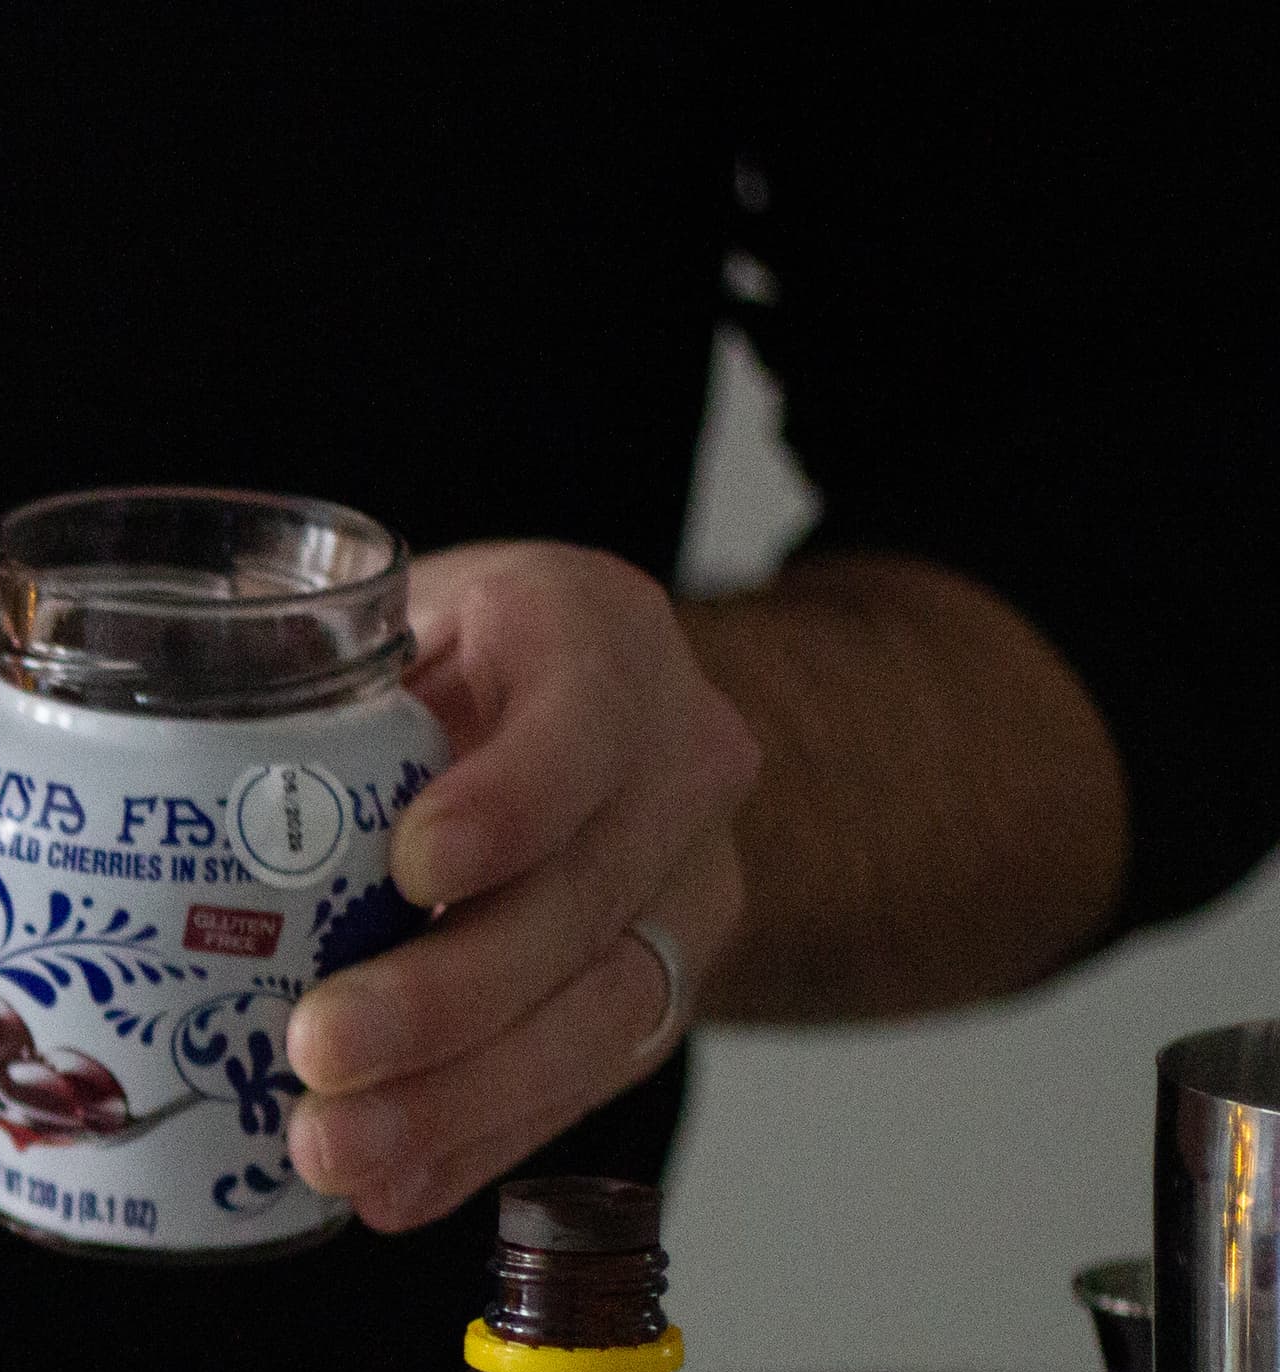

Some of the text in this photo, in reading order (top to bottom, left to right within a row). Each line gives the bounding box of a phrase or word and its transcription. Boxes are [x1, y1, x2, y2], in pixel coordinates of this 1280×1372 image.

[47, 842, 164, 883] CHERRIES
[171, 856, 195, 882] IN
[193, 910, 275, 935] GLUTEN
